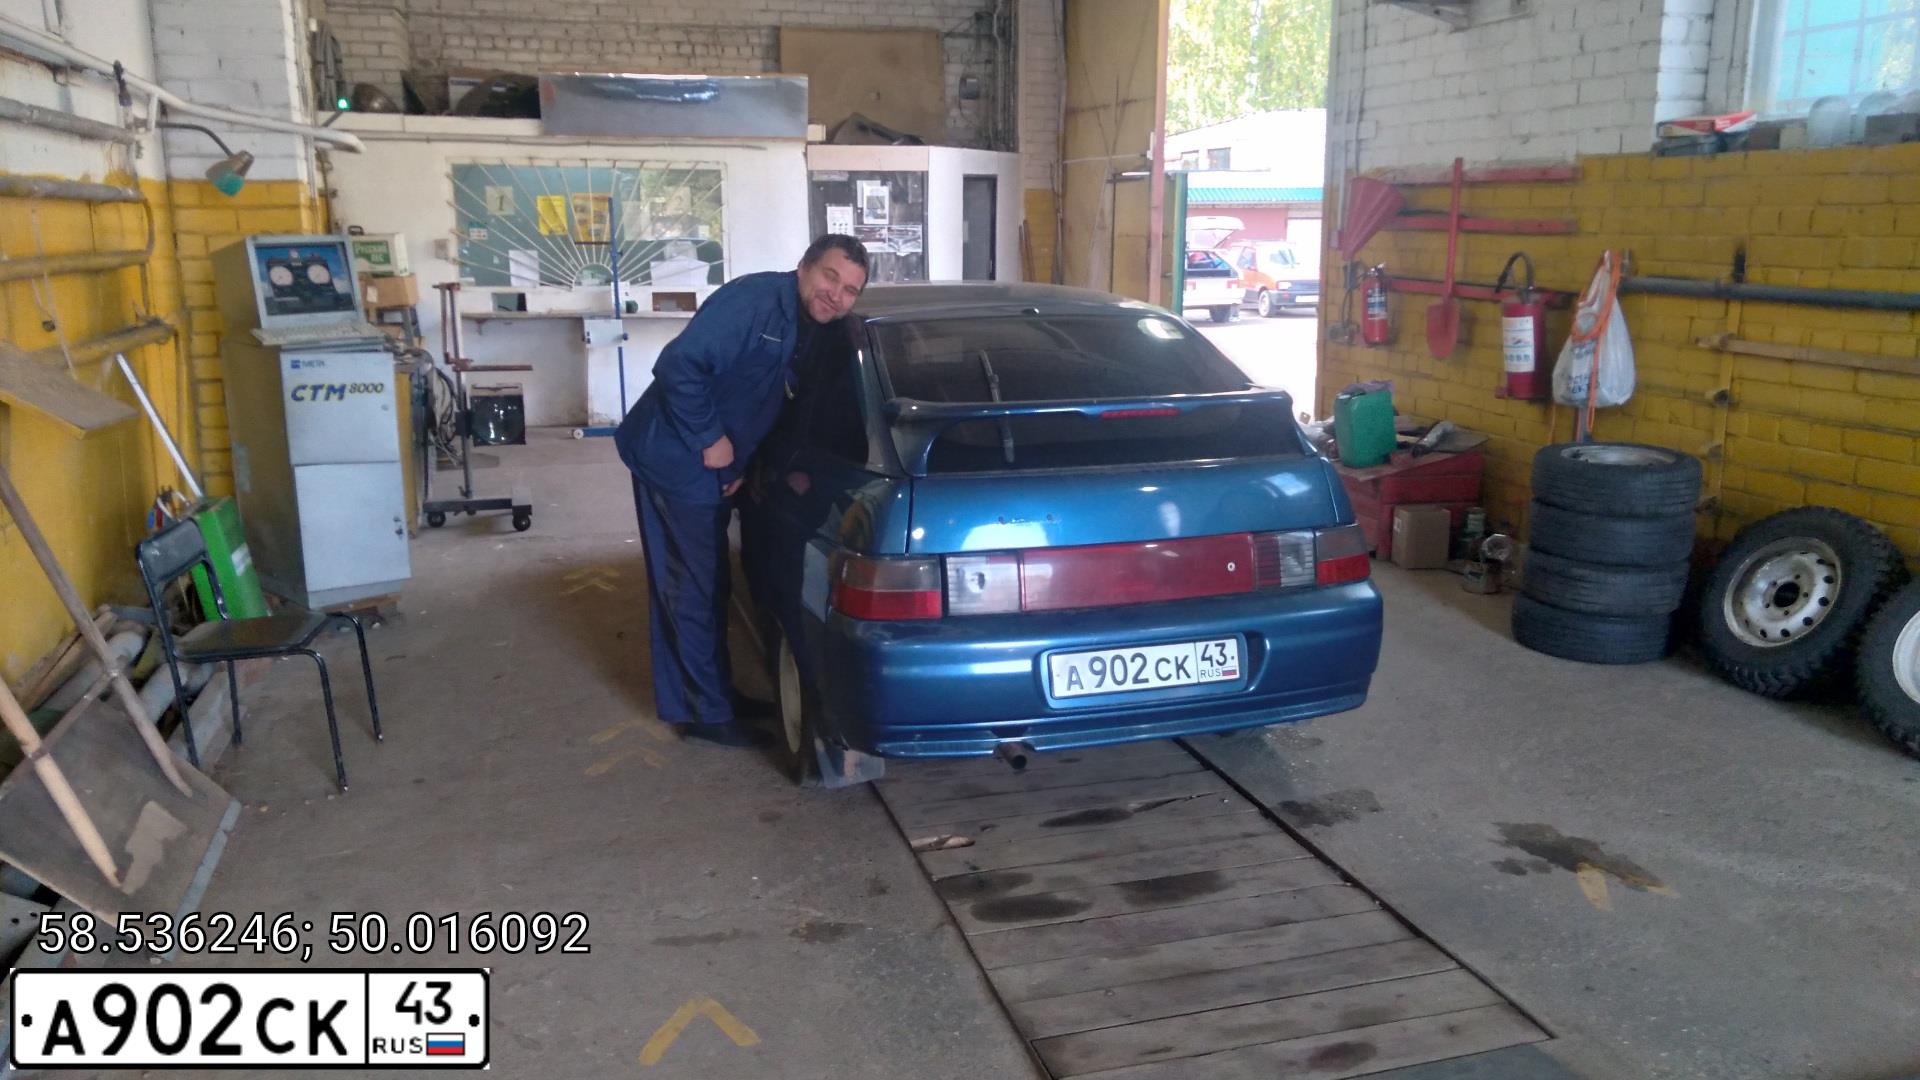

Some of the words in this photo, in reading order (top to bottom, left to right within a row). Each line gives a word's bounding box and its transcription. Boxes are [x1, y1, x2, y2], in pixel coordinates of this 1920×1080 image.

[348, 382, 384, 394] 8000
[1200, 642, 1228, 668] 43
[1200, 668, 1222, 679] RUS
